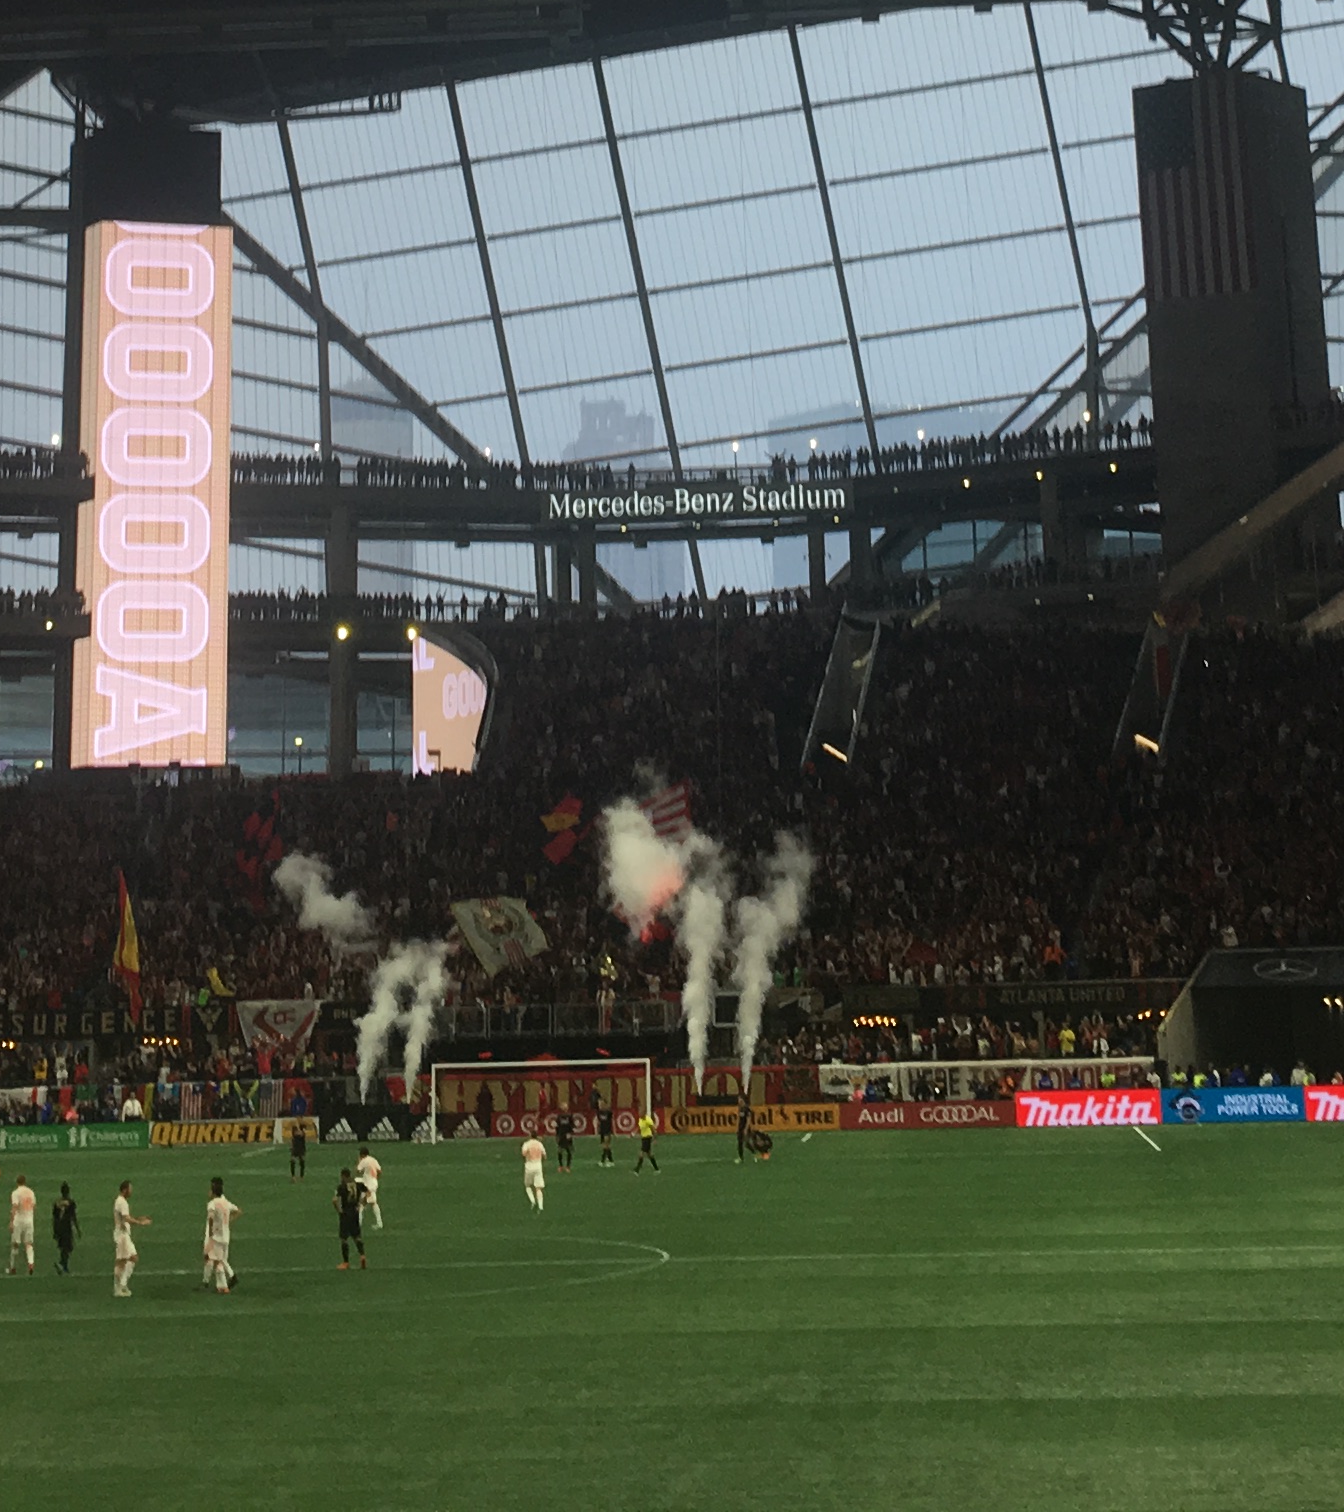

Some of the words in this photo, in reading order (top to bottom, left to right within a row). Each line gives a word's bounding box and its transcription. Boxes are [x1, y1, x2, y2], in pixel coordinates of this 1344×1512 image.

[549, 488, 734, 518] Mercedes-Benz
[743, 485, 846, 513] Stadium
[1224, 1093, 1290, 1105] INDUSTRIAL
[794, 1110, 834, 1125] TIRE
[858, 1107, 905, 1124] Audi
[1217, 1104, 1260, 1116] POWER
[1262, 1103, 1299, 1115] TOOLS
[151, 1120, 273, 1146] QUIKRETE
